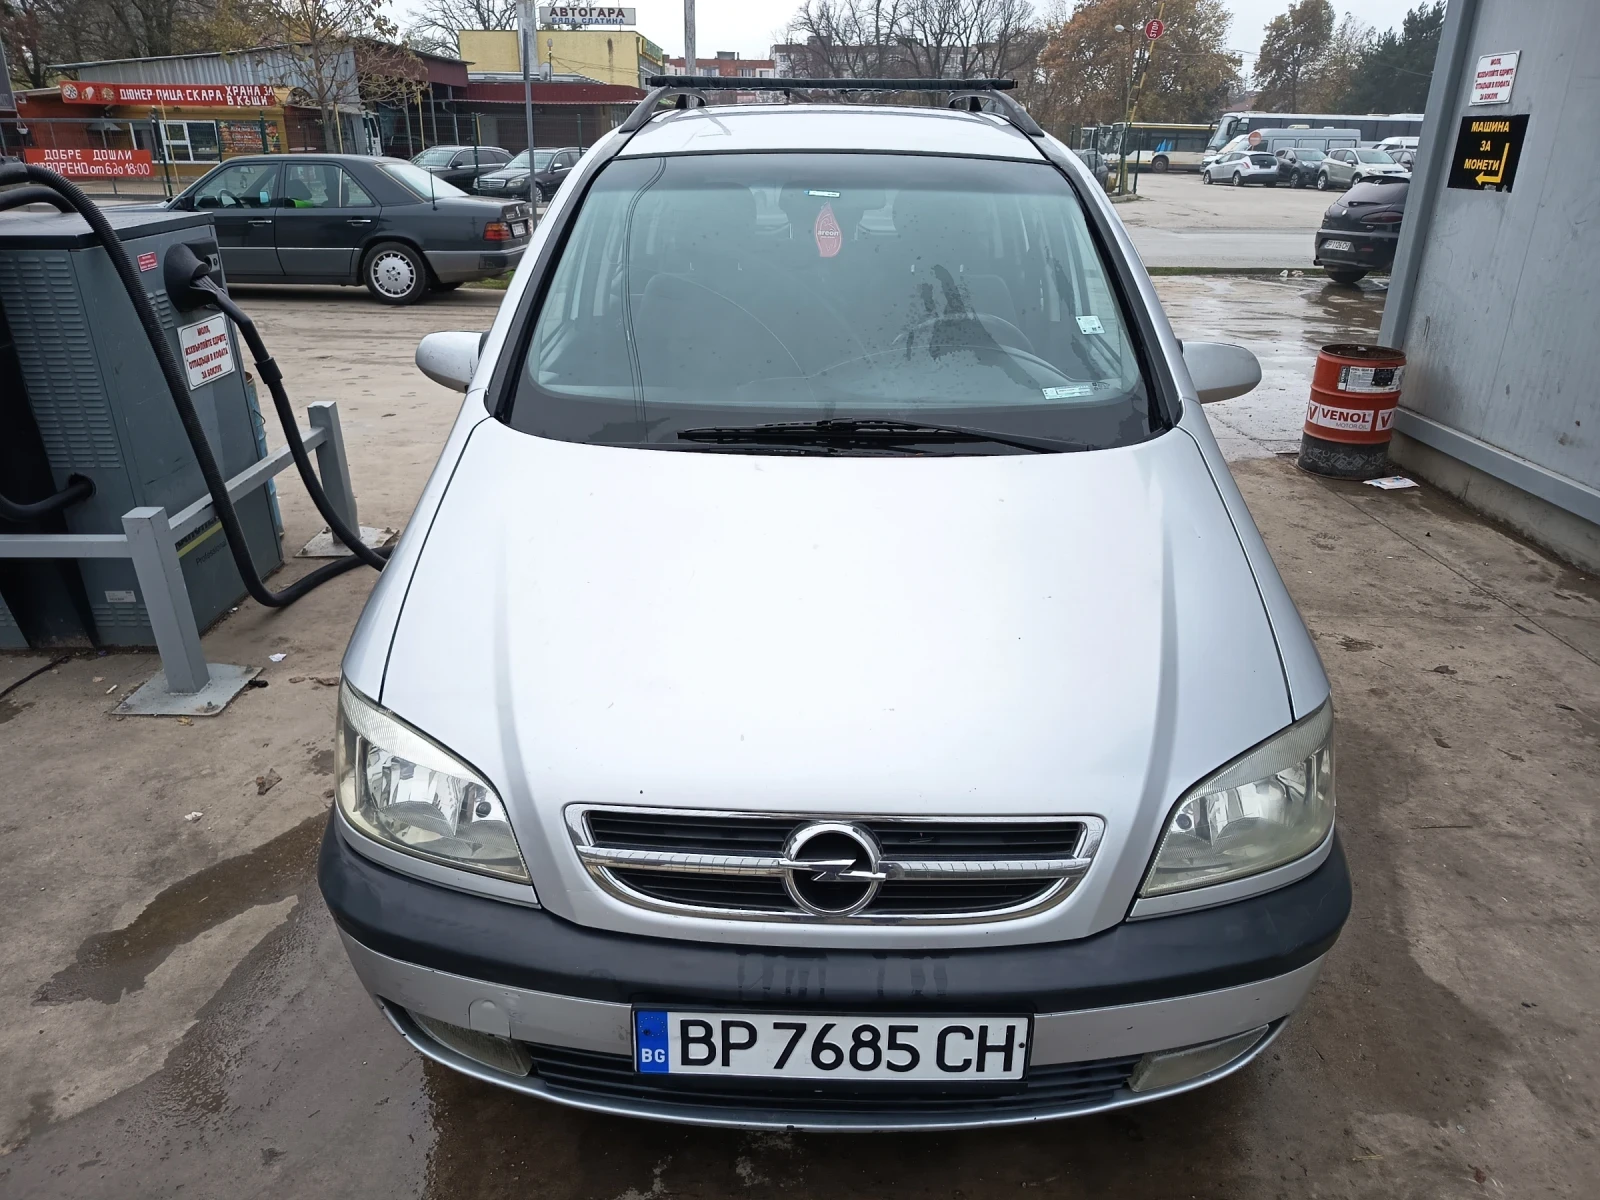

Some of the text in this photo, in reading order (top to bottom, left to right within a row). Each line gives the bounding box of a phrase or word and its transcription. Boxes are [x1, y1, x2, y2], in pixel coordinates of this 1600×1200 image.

[550, 8, 615, 17] АВТОГАРА
[1149, 21, 1159, 37] STOP
[120, 88, 223, 101] ДЮНЕР ПИЦА СКАРА
[225, 85, 274, 96] ХРАНА ЗА
[226, 96, 234, 105] В
[1471, 121, 1510, 132] МАШИНА
[1480, 140, 1491, 151] ЗА
[44, 149, 132, 161] ДОБРЕ ДОШЛИ
[105, 162, 113, 175] 6
[124, 162, 150, 175] 18:00
[1464, 158, 1500, 170] МОНЕТИ
[201, 370, 207, 379] ЗА
[1321, 408, 1370, 423] VENOL
[679, 1018, 1017, 1073] BP 7685 CH
[641, 1047, 667, 1063] BG
